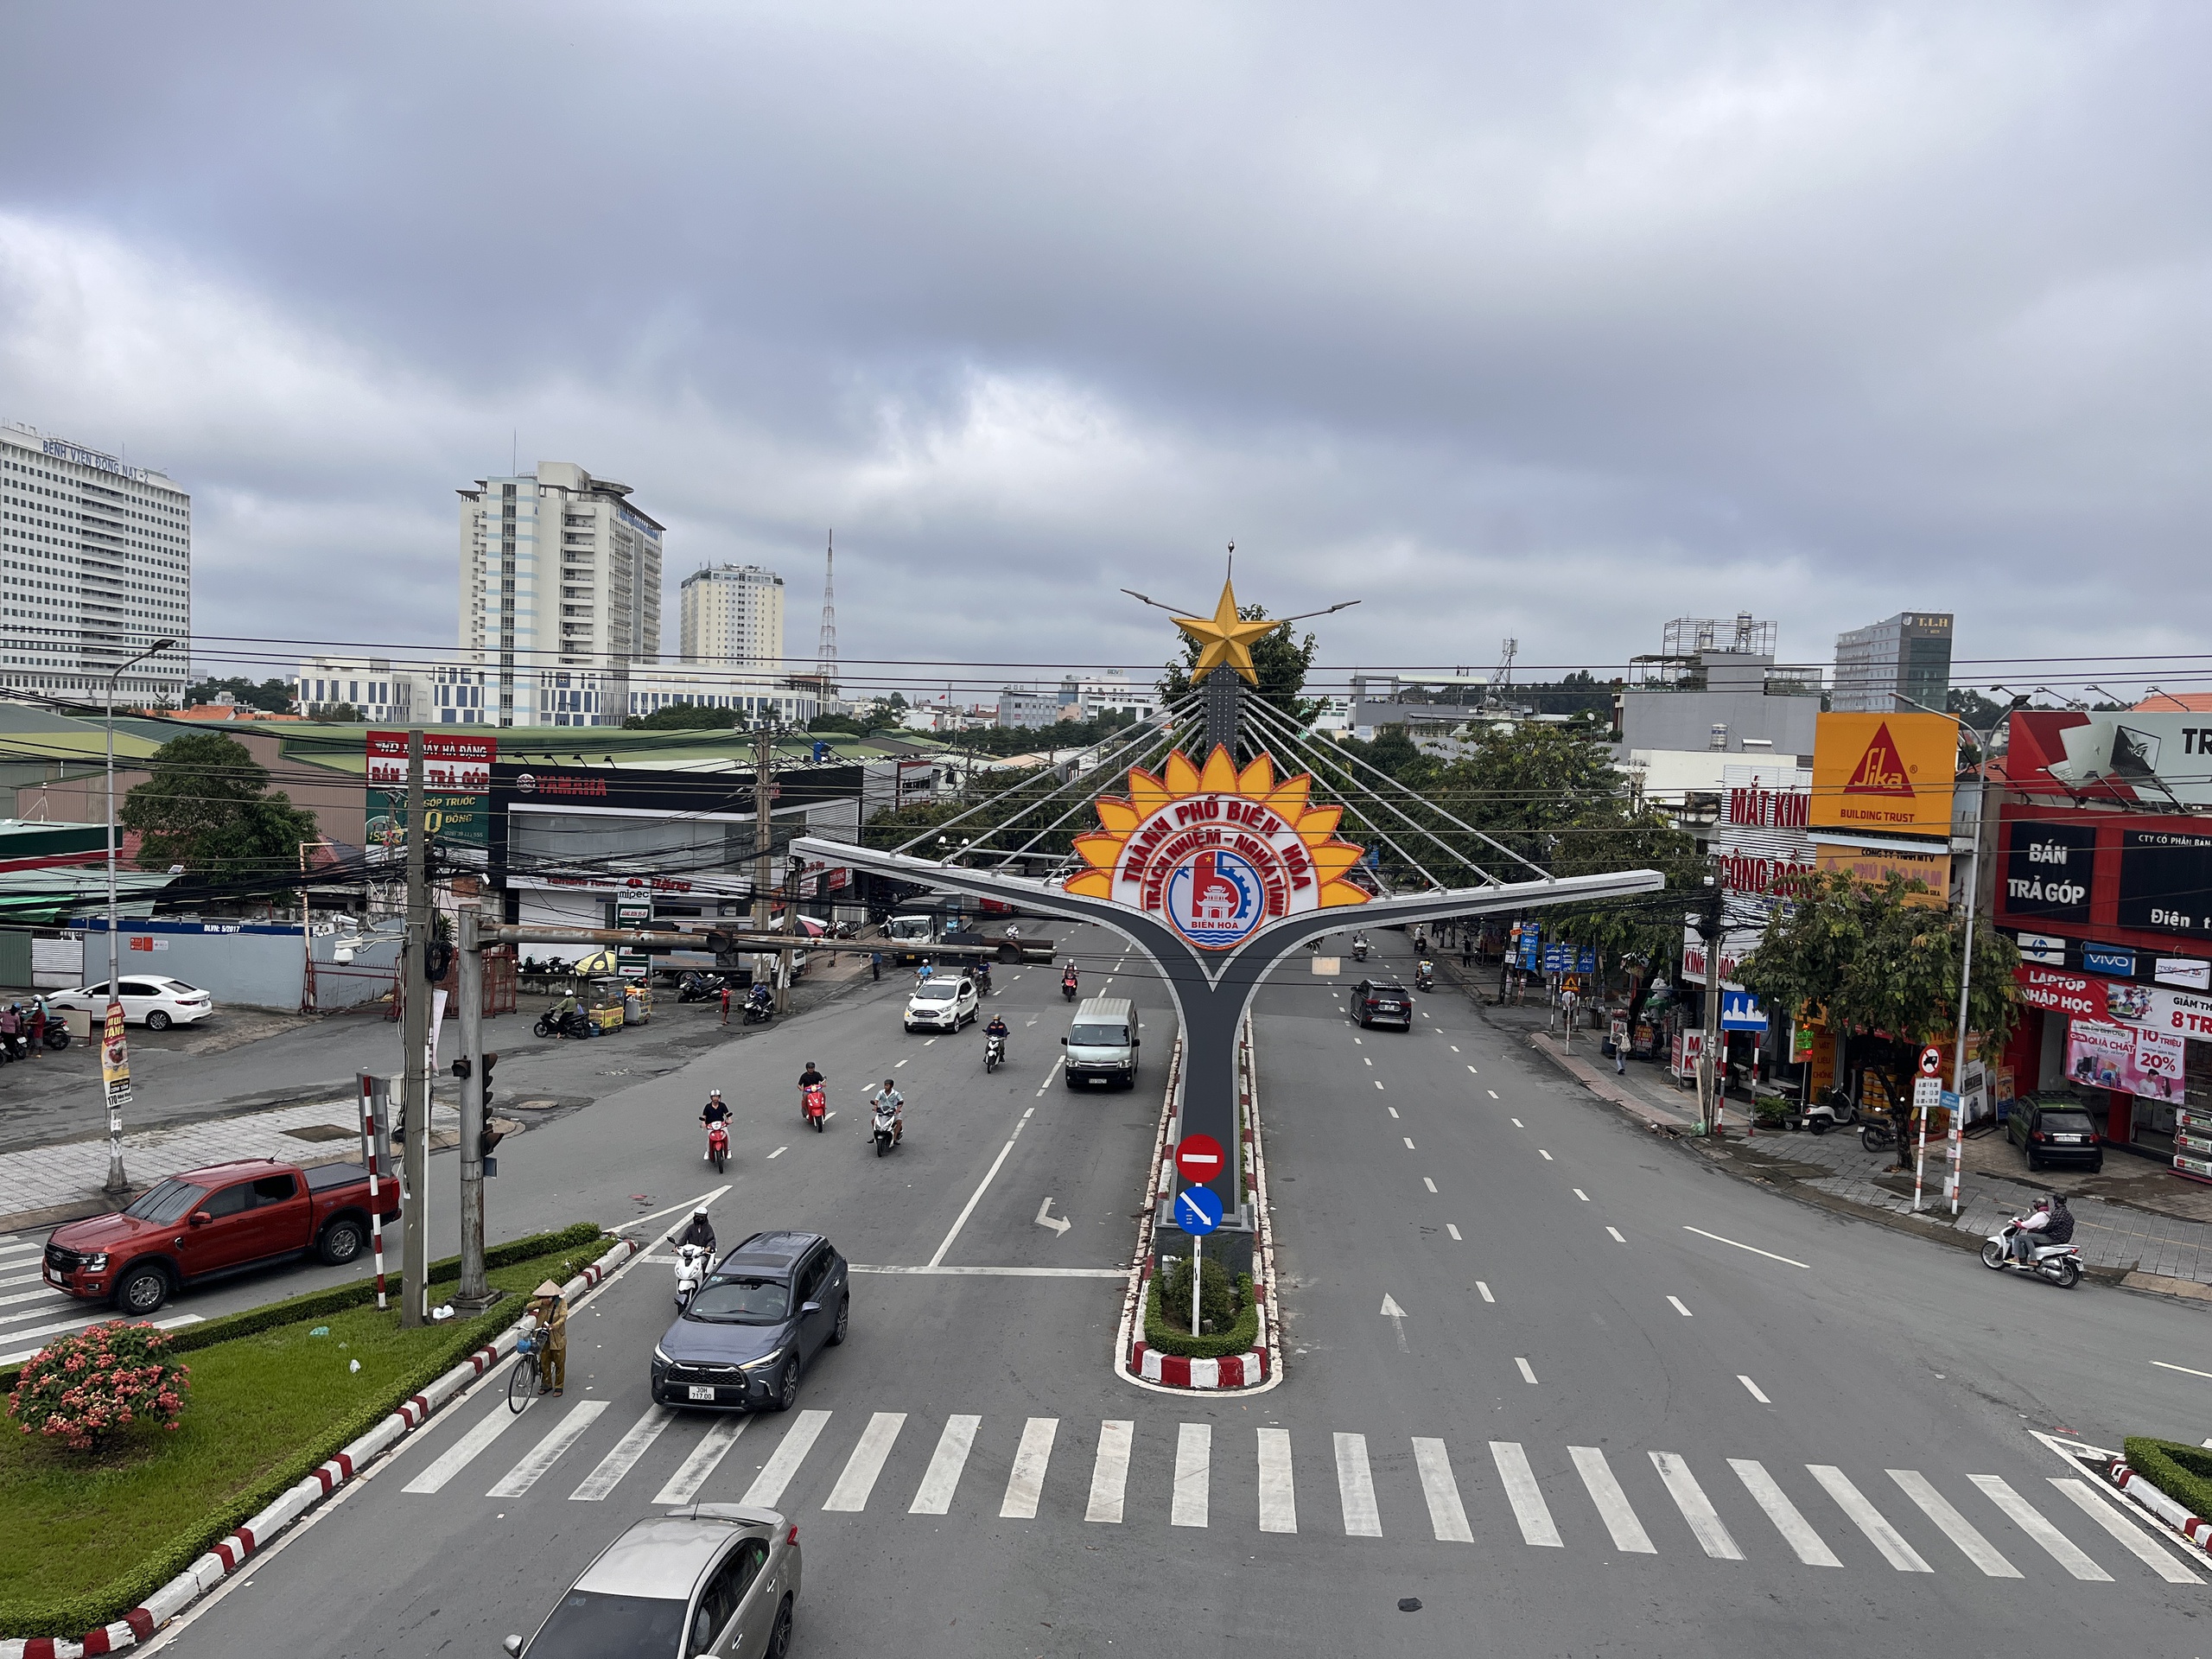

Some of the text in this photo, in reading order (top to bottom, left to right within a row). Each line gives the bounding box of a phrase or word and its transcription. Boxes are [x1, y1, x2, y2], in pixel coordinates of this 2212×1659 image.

[122, 465, 137, 480] NAI
[372, 763, 400, 784] BÁN
[429, 765, 457, 788] TRẢ
[1853, 747, 1903, 789] Sika
[536, 775, 607, 796] YAMAHA
[1729, 775, 1811, 830] MẮT KÍN
[1840, 809, 1915, 823] BUILDING TRUST
[1122, 793, 1312, 891] THÀNH PHỐ BIÊN HÒA
[2029, 838, 2068, 865] BÁN
[1917, 854, 1936, 862] MTV
[1145, 855, 1173, 912] TRÁCH
[1165, 827, 1221, 861] NHIỆM
[1234, 834, 1278, 879] NGHĨA
[1267, 874, 1287, 917] TÌNH
[1719, 848, 1769, 896] CỘNG
[619, 889, 650, 899] mipec
[2007, 874, 2086, 905] TRẢ GÓP
[1192, 919, 1238, 929] BIÊN HOÀ
[2151, 908, 2191, 931] Điện
[1685, 947, 1705, 975] KÍNH
[2029, 970, 2087, 992] LAPTOP
[2061, 995, 2094, 1014] HỌC
[2173, 995, 2198, 1010] GIẢM
[2171, 1011, 2183, 1028] 8
[2088, 1037, 2108, 1048] QUÀ
[2109, 1040, 2135, 1053] CHẤT
[2143, 1029, 2182, 1048] 10 TRIỆU
[2140, 1052, 2176, 1072] 20%
